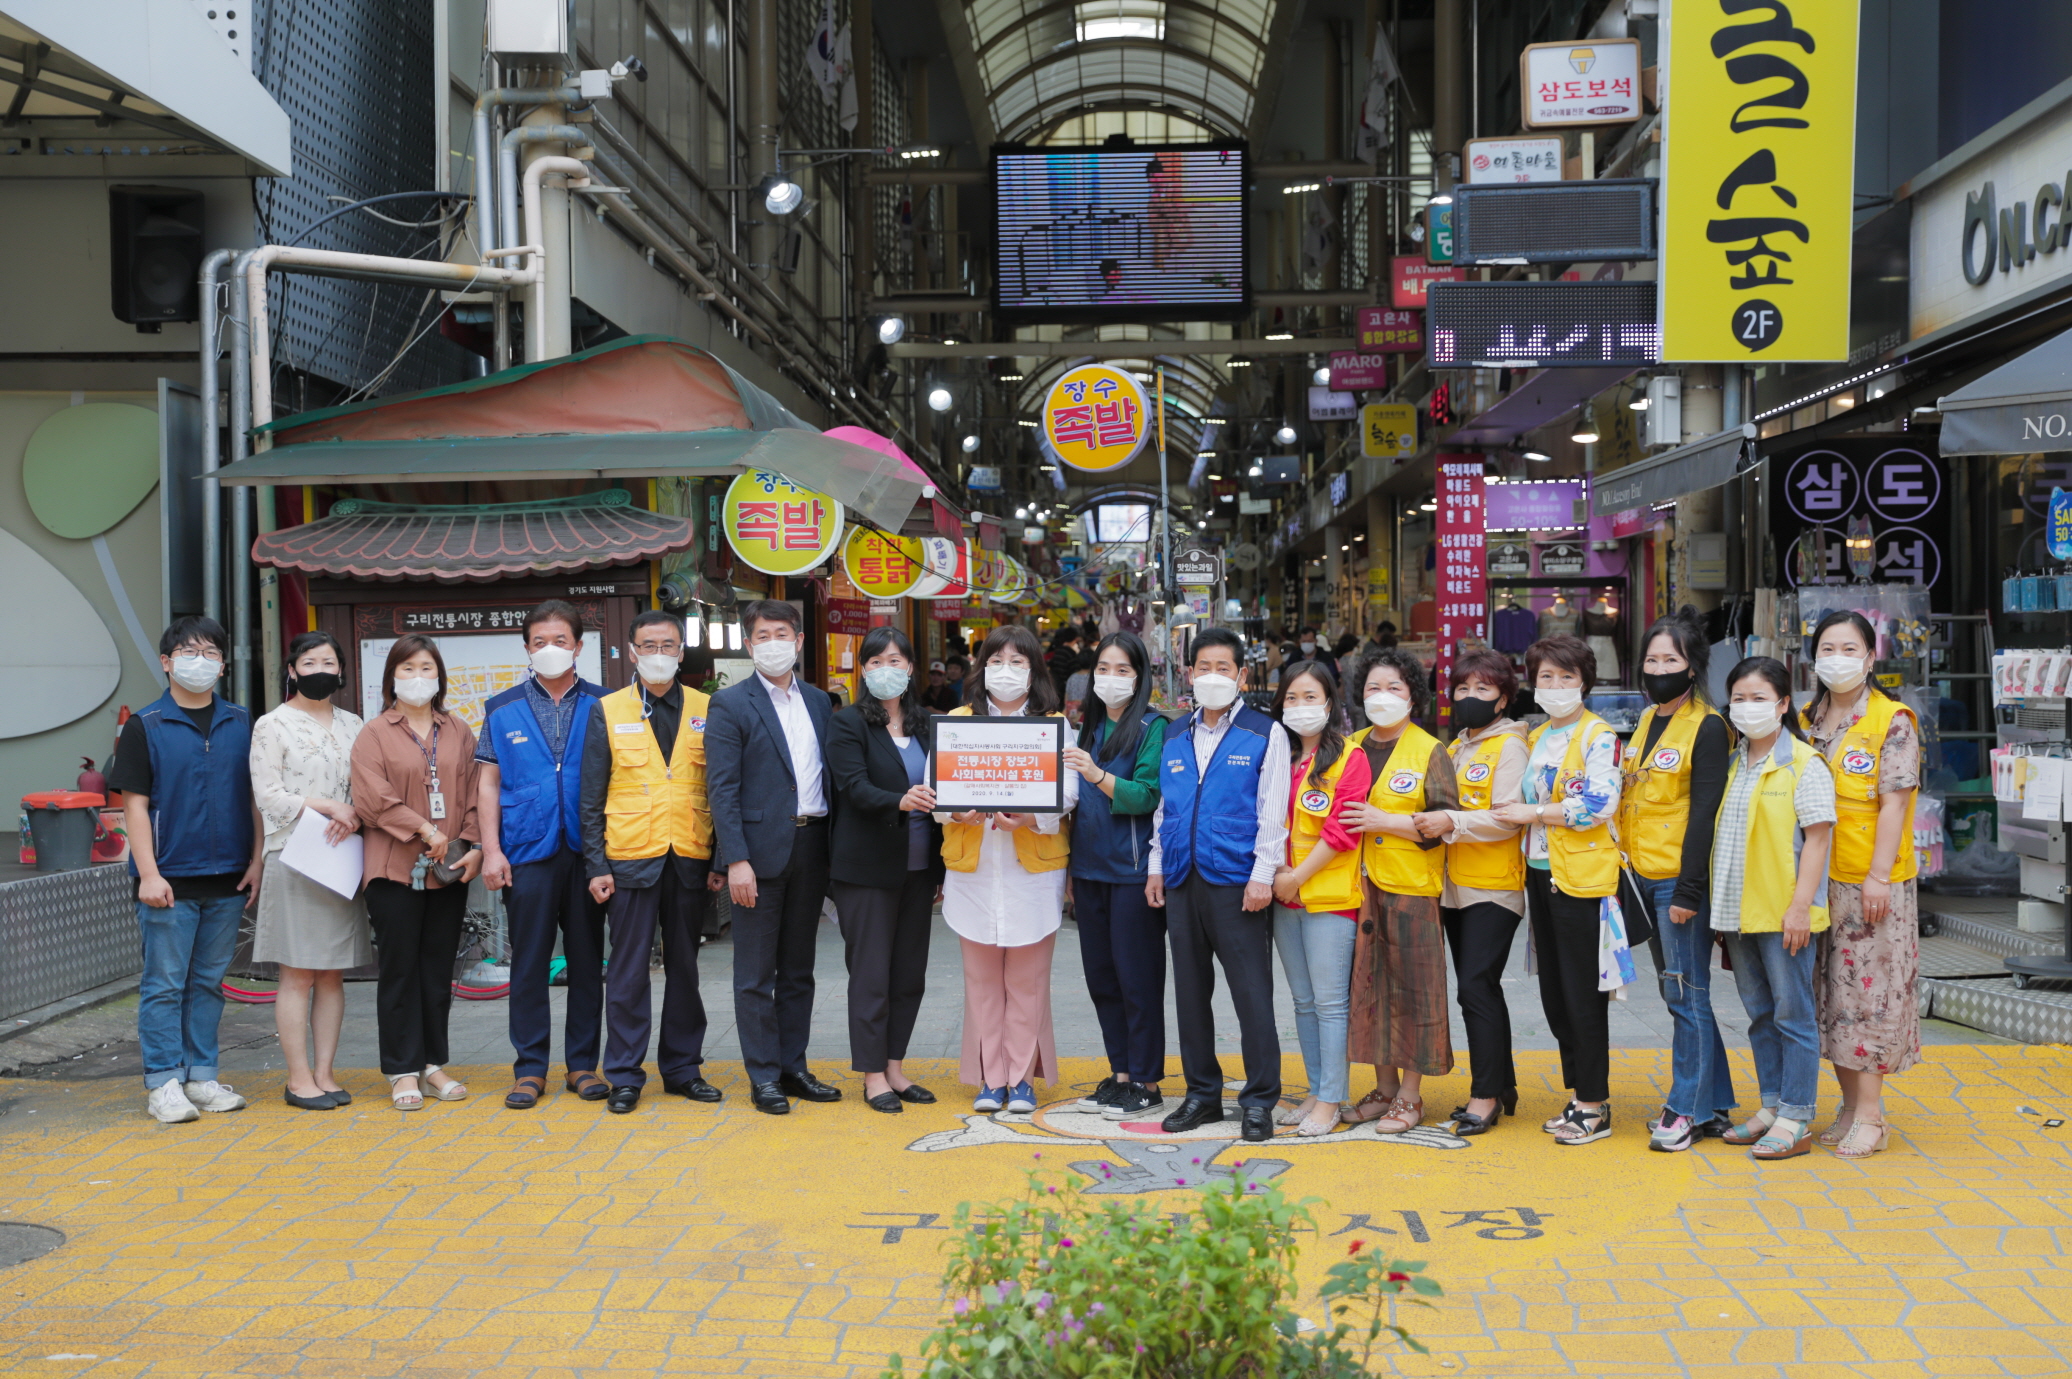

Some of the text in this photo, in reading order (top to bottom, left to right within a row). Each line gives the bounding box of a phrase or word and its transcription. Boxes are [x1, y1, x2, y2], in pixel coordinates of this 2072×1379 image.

[1538, 77, 1632, 102] 삼도보석
[1493, 151, 1558, 171] 어촌마을
[1405, 265, 1452, 275] BATMAN
[1369, 311, 1411, 326] 고은사
[1742, 310, 1774, 339] 2F
[1362, 329, 1419, 345] 종합화장품
[1333, 354, 1383, 369] MARO
[1064, 377, 1117, 404] 장수
[1052, 397, 1138, 451] 족발
[737, 499, 825, 550] 족발
[866, 538, 903, 555] 착한
[858, 557, 914, 585] 통닭
[1177, 562, 1213, 573] 맛있는과일
[568, 584, 615, 595] 경기도 지원사업
[406, 611, 484, 629] 구리전통시장
[957, 755, 1039, 767] 전통시장 장보기
[951, 769, 1044, 781] 사회복지시설 후원
